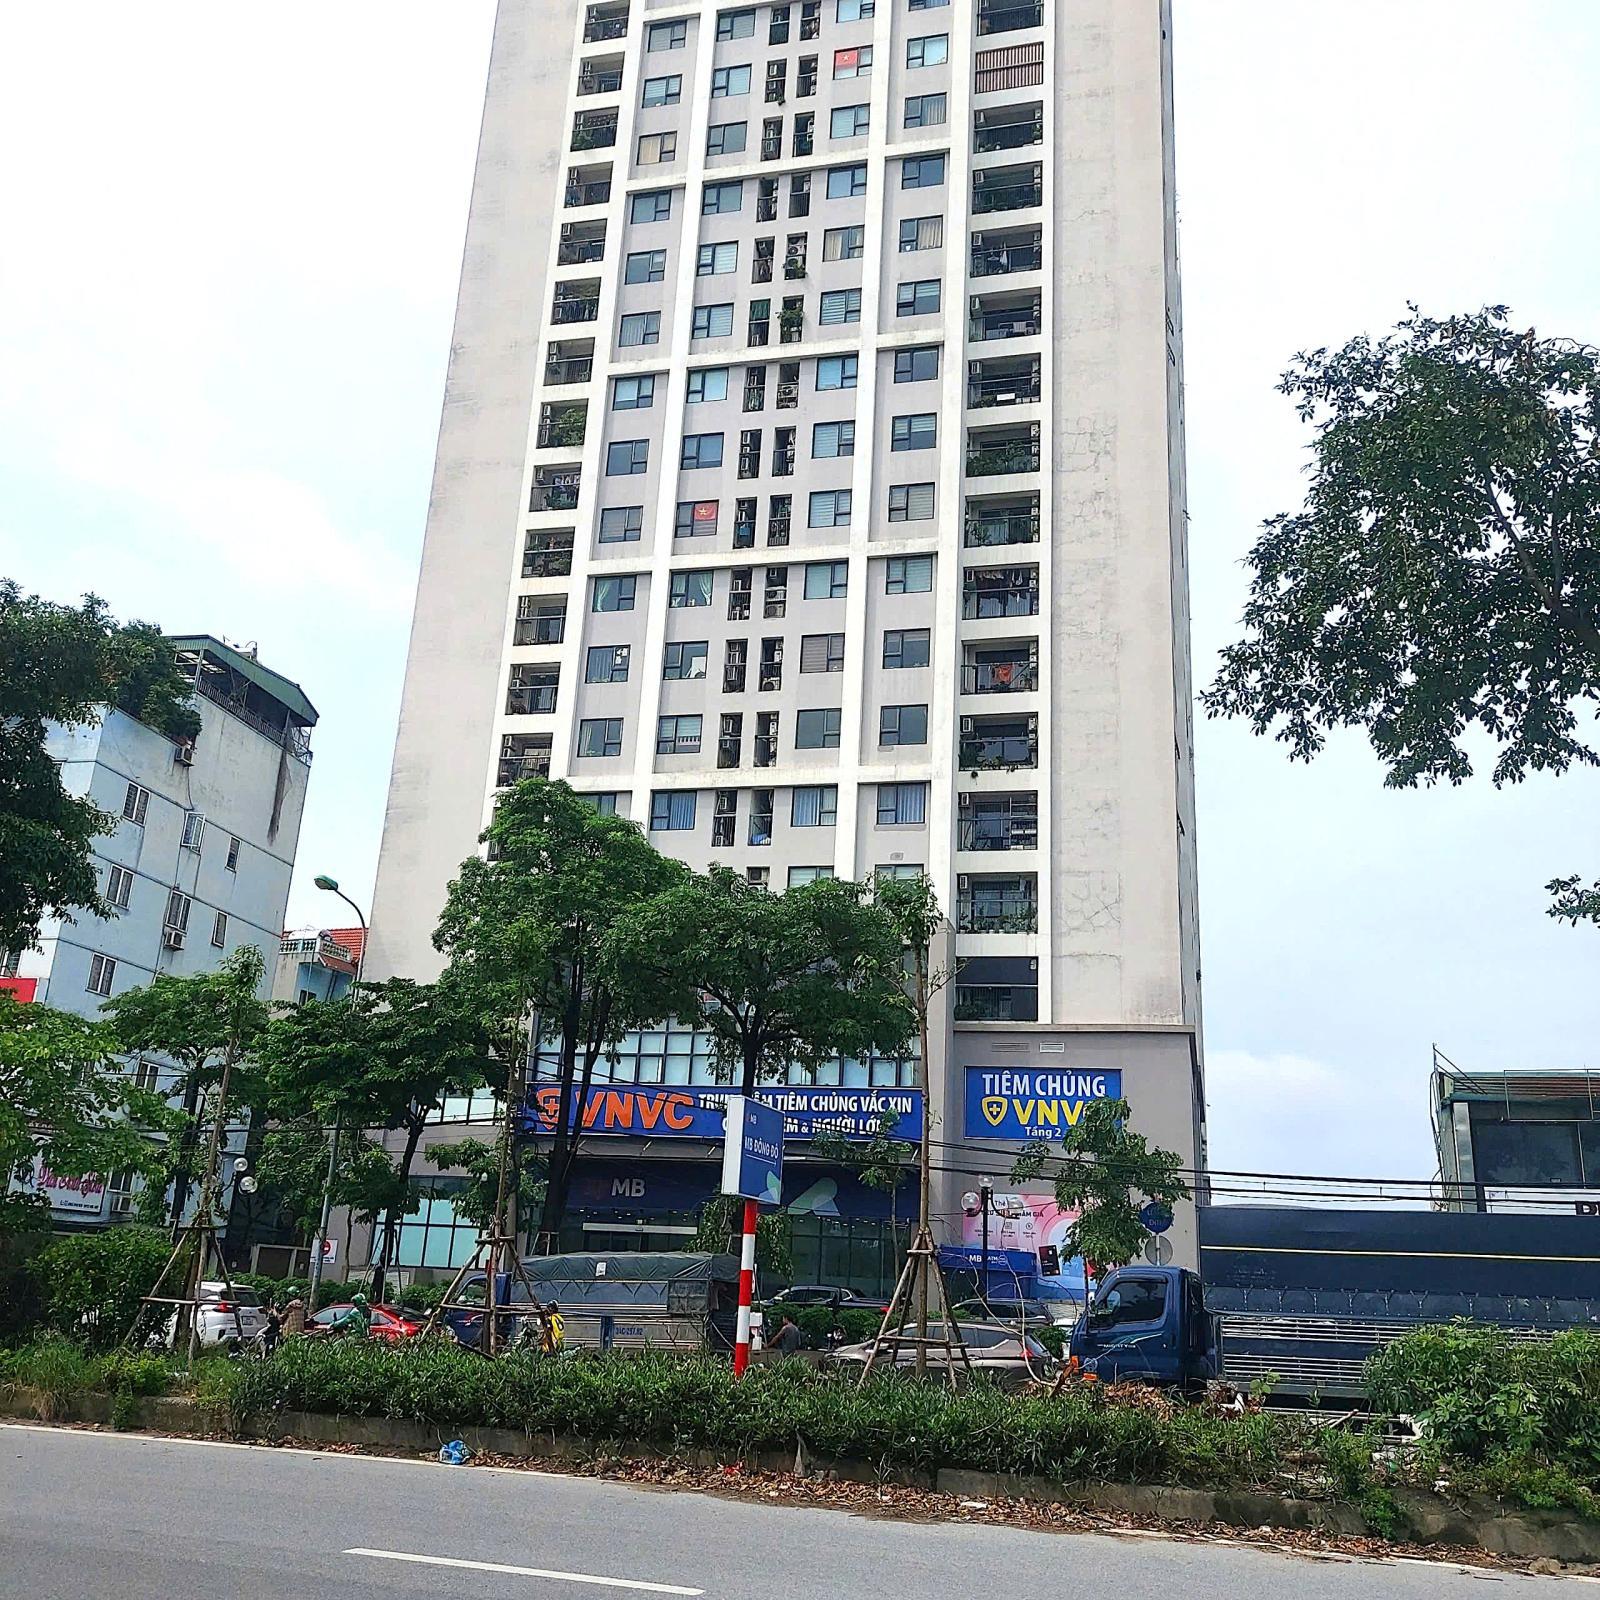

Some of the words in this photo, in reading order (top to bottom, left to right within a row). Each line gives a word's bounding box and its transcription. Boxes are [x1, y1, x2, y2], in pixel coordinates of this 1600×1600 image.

[982, 1069, 1030, 1096] TIÊM
[1035, 1070, 1106, 1097] CHỦNG
[575, 1091, 694, 1130] VNVC
[698, 1093, 728, 1110] TRU
[775, 1091, 808, 1111] TIÊM
[810, 1091, 858, 1112] CHỦNG
[860, 1089, 886, 1113] VẮC
[888, 1096, 913, 1113] XIN
[1012, 1099, 1085, 1126] VNV
[800, 1122, 809, 1134] &
[1025, 1126, 1053, 1139] Tầng
[1054, 1127, 1062, 1138] 2
[744, 1135, 753, 1151] MB
[611, 1178, 646, 1197] MB
[969, 1254, 982, 1263] MB
